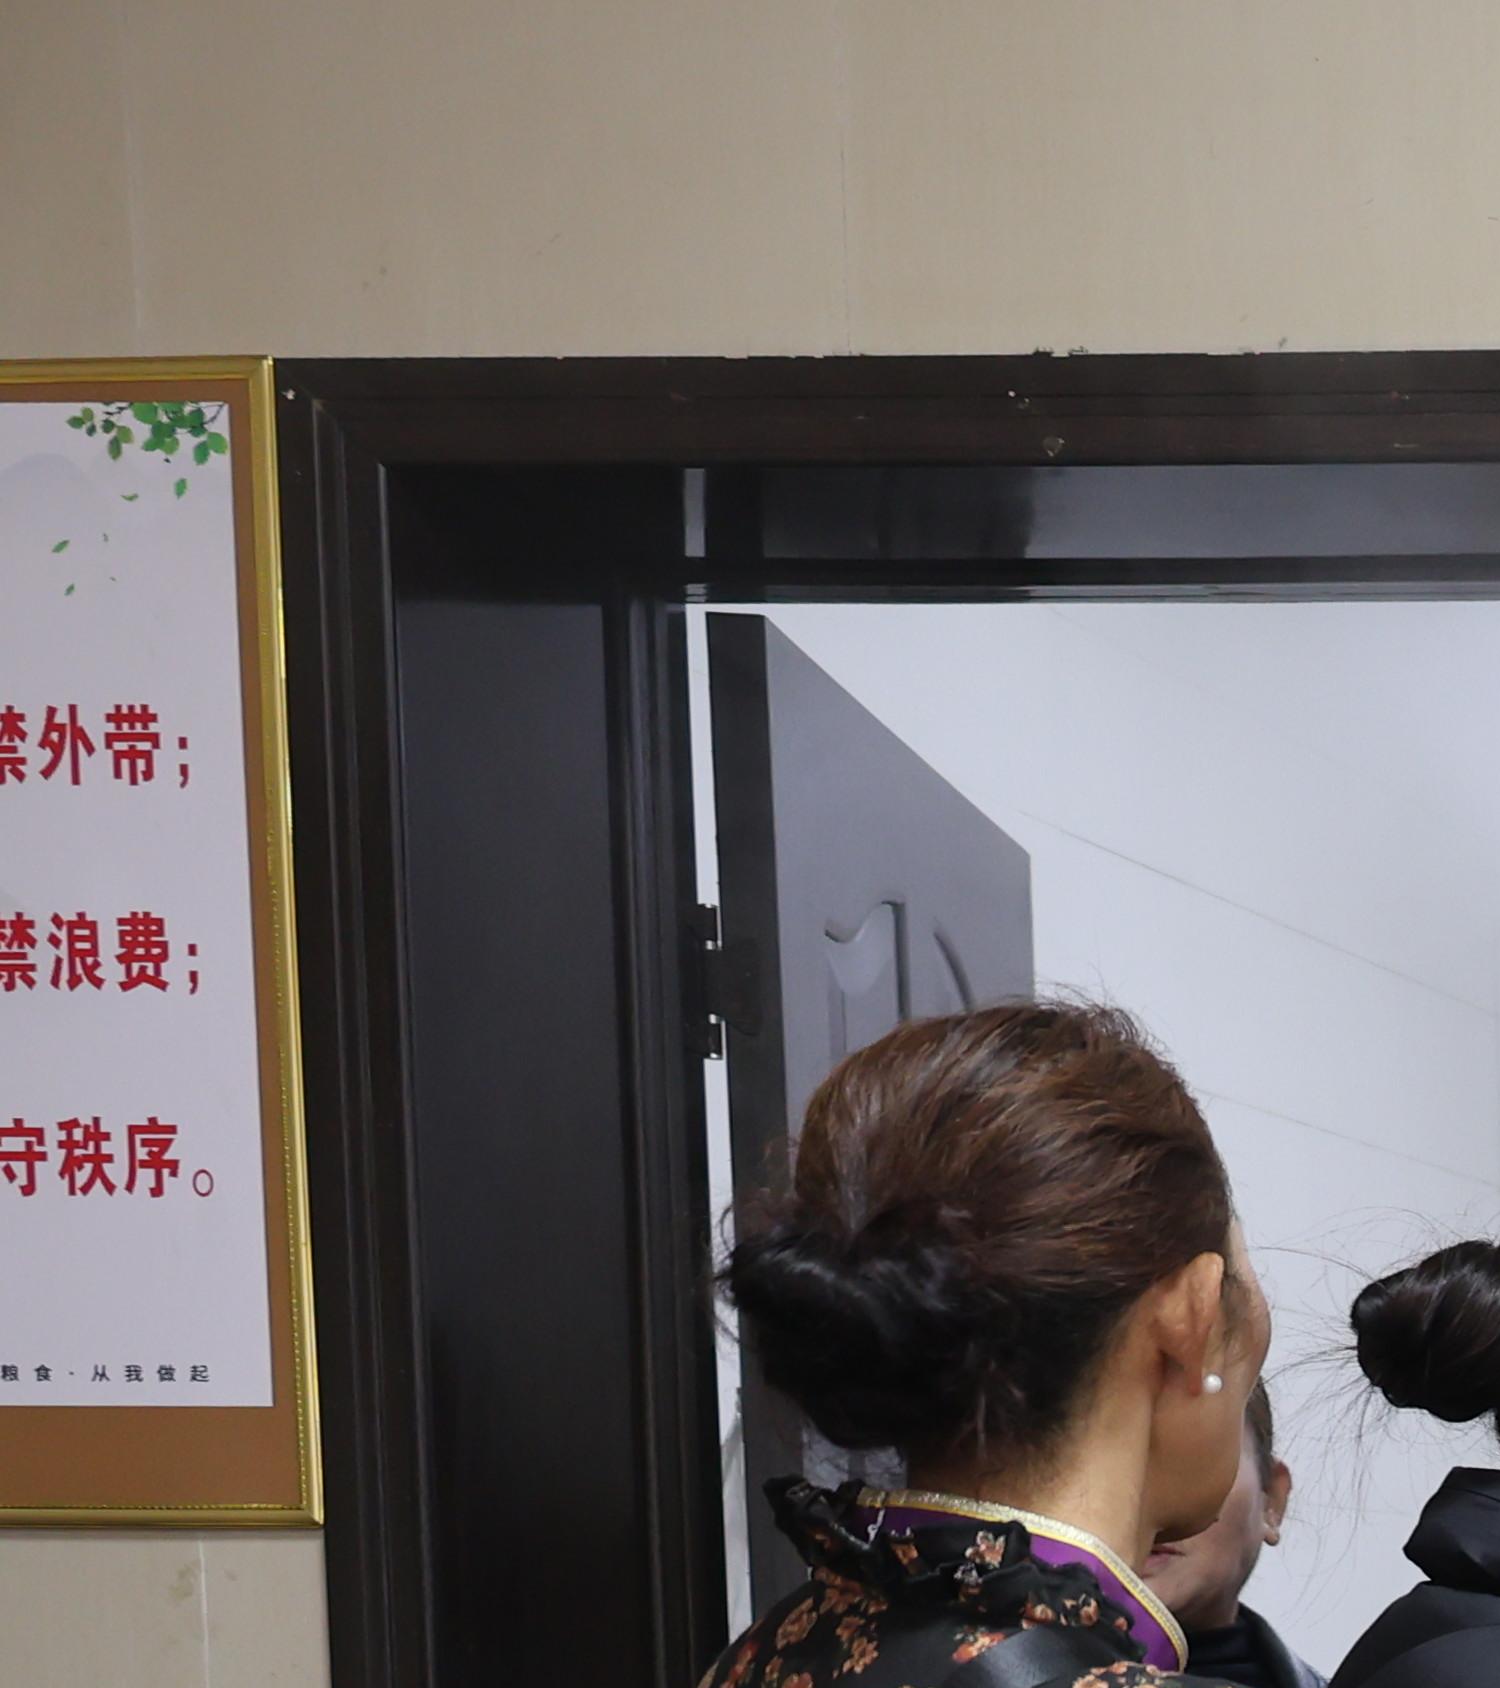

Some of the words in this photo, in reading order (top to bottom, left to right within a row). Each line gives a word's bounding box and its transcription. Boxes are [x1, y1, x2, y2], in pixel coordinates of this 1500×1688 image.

[0, 911, 198, 995] 禁浪费；
[0, 1116, 214, 1198] 守秩序。
